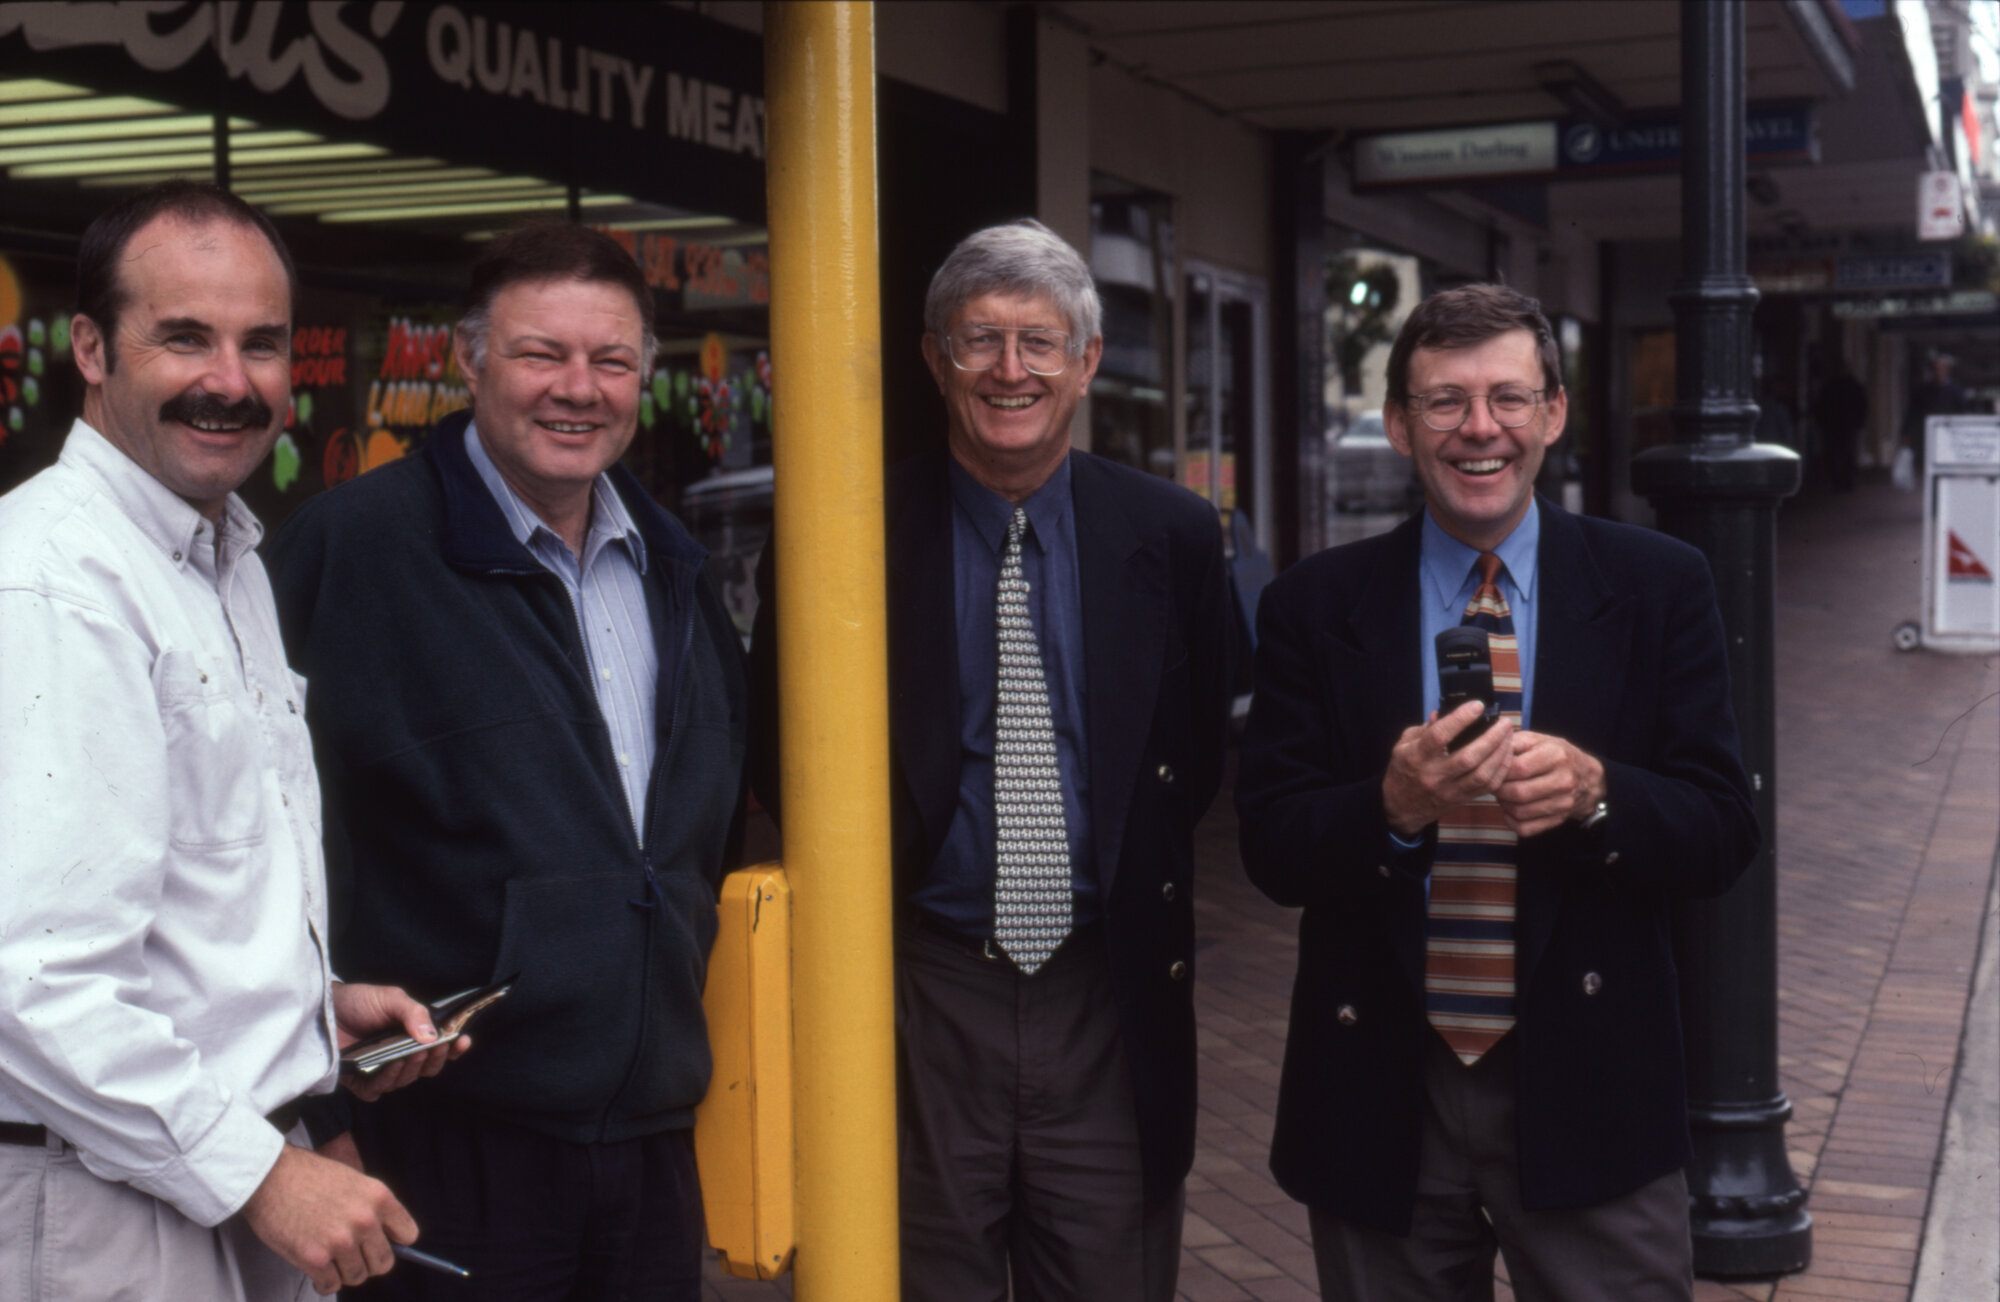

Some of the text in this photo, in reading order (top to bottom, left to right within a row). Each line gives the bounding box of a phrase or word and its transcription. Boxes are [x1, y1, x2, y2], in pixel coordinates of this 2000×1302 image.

[427, 5, 654, 130] QUALITY
[291, 328, 347, 355] RDER
[291, 357, 346, 387] YOUR
